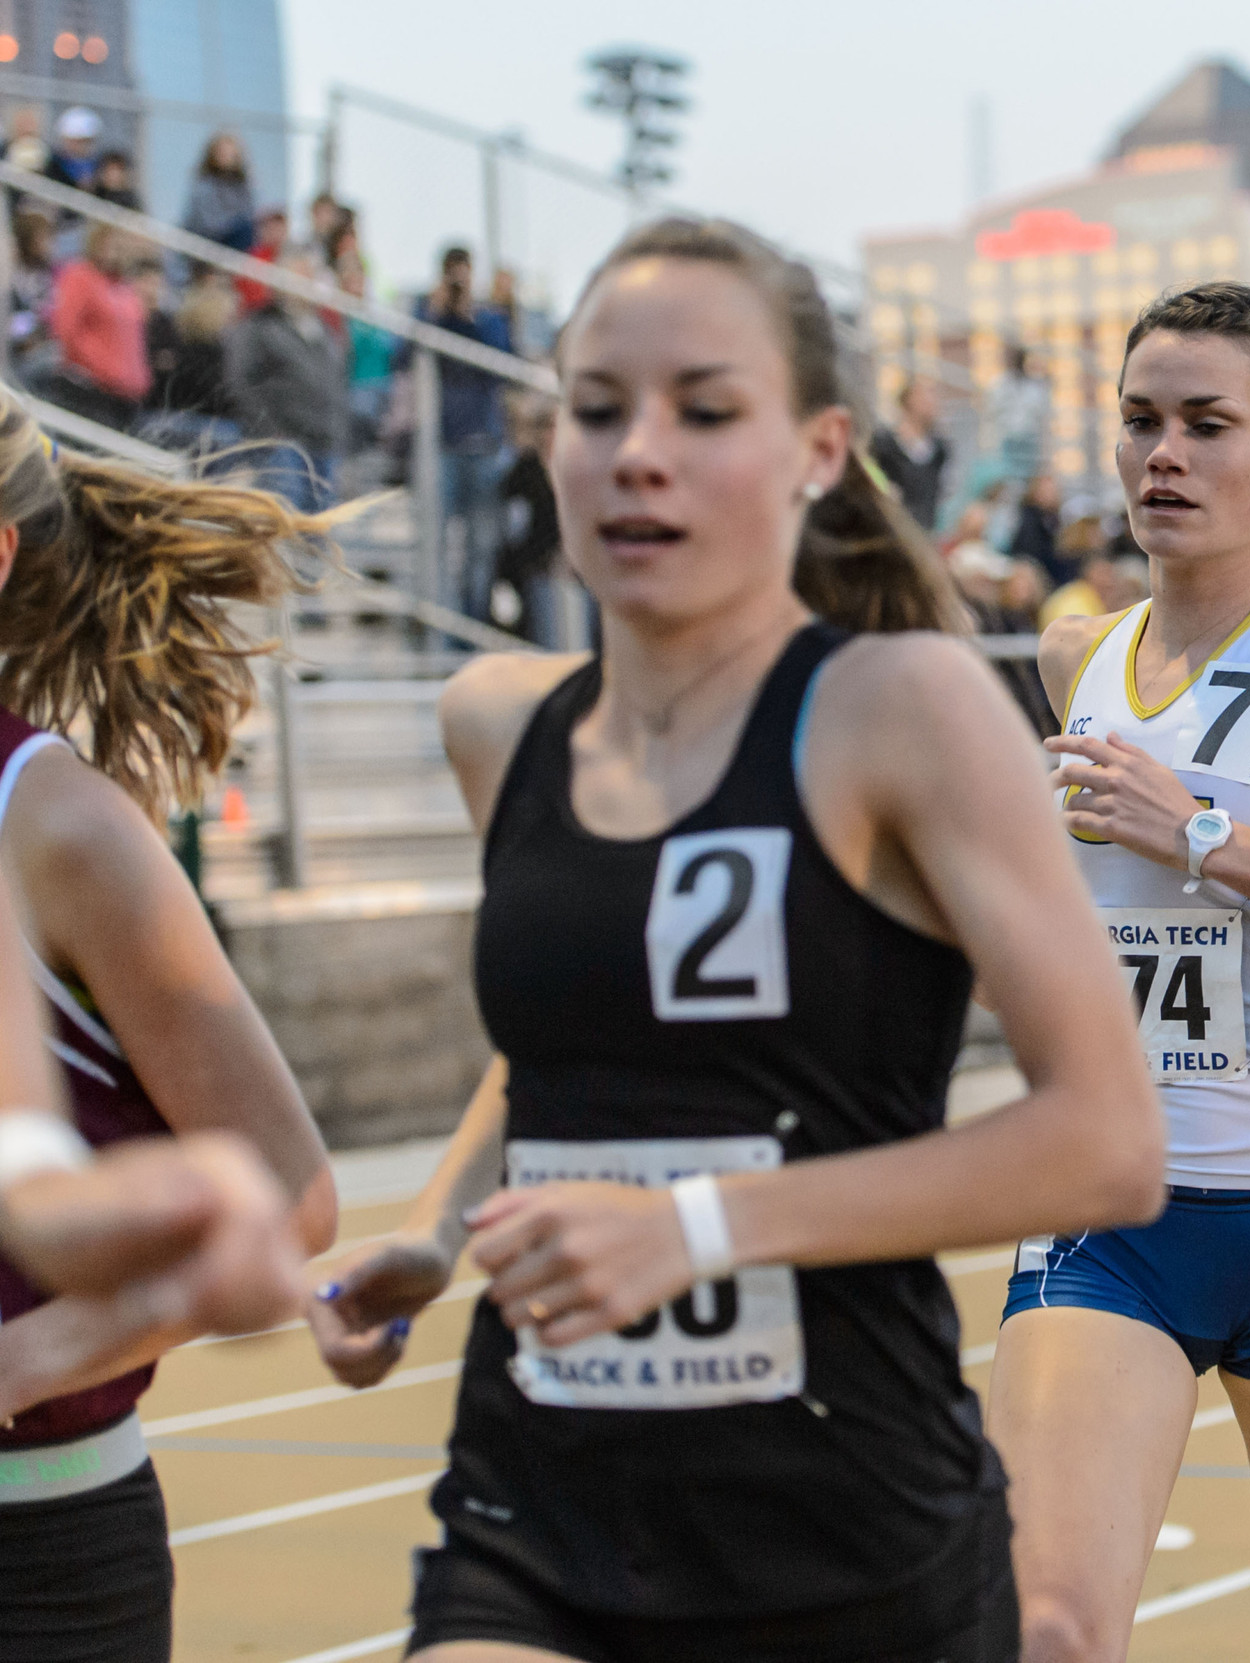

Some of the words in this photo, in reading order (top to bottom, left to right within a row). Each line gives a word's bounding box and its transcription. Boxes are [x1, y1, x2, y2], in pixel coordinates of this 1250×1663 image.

[1068, 716, 1093, 736] ACC
[671, 847, 757, 1000] 2
[1107, 925, 1160, 945] RGIA
[1165, 925, 1228, 946] TECH
[1161, 1052, 1229, 1071] FIELD
[540, 1356, 624, 1385] RACK
[673, 1353, 774, 1386] FIELD
